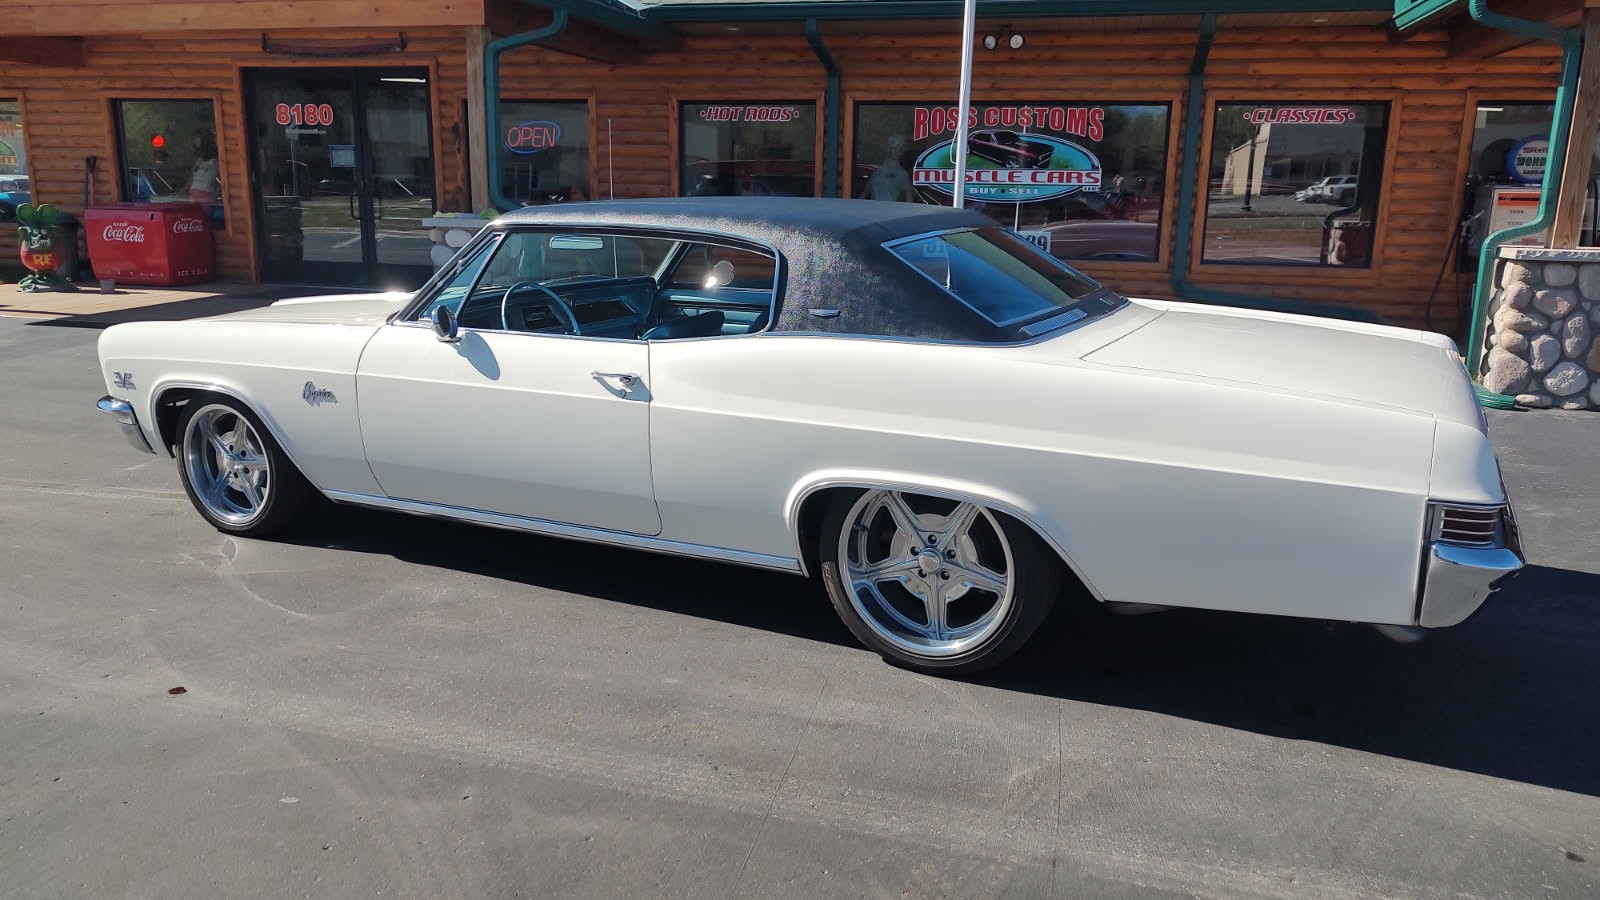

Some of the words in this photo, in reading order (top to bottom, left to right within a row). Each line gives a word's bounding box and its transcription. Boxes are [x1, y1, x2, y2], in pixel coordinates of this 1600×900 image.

[275, 103, 334, 126] 8180
[705, 106, 743, 121] HOT
[744, 106, 794, 121] RODS
[1250, 107, 1349, 124] CLASSICS
[913, 106, 978, 141] ROSS
[507, 127, 556, 148] OPEN
[913, 169, 1022, 183] MUSCLE
[1030, 169, 1100, 184] CARS
